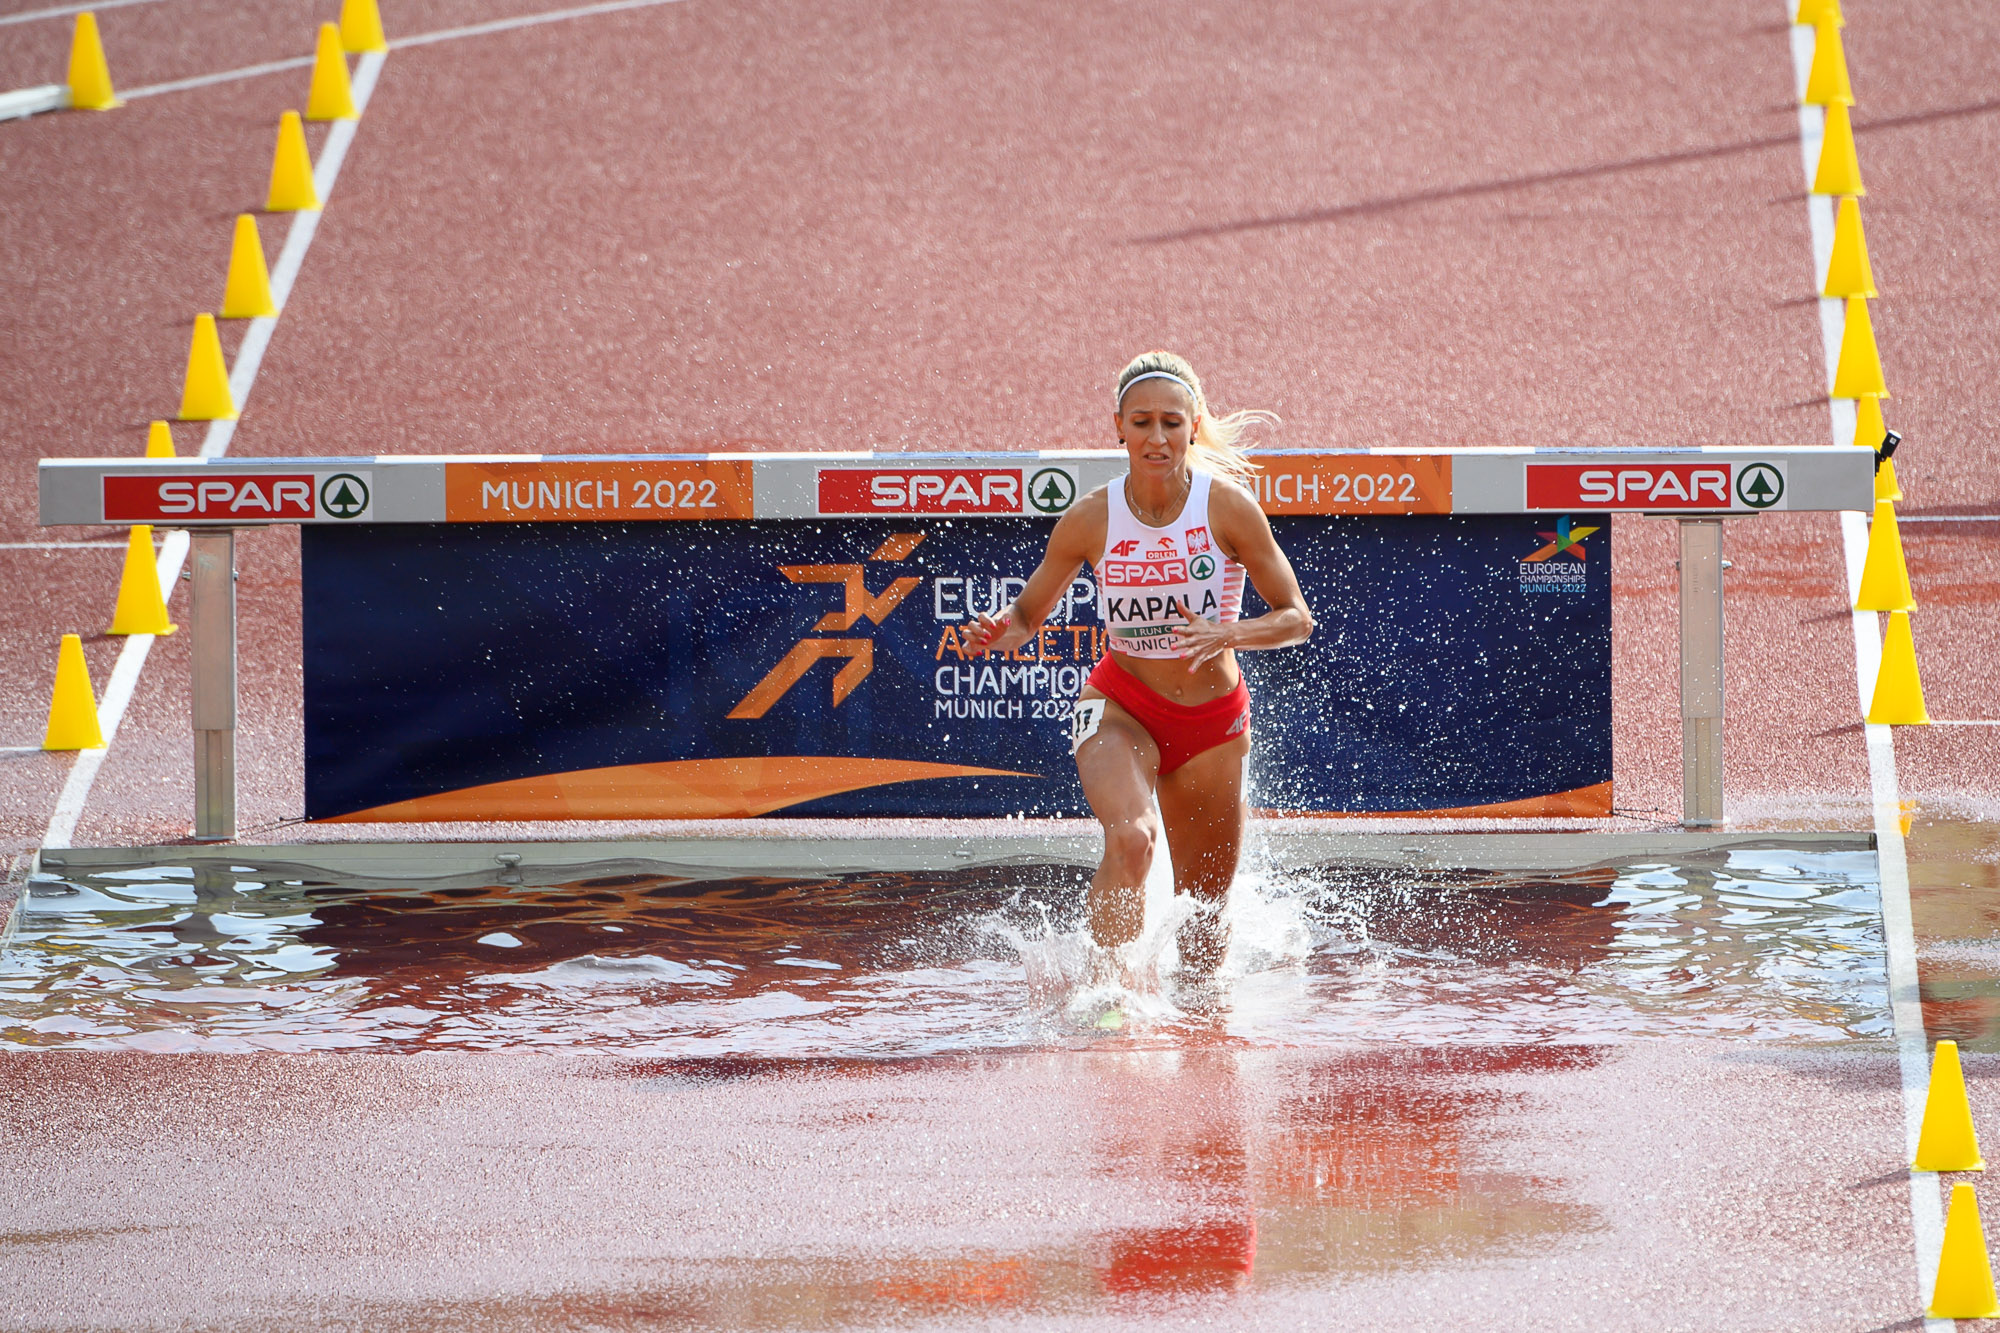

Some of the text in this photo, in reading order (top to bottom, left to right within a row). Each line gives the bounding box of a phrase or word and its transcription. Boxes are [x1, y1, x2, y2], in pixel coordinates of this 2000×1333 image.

[158, 480, 311, 513] SPAR
[481, 480, 717, 510] MUNICH 2022
[870, 474, 1019, 507] SPAR
[1333, 474, 1416, 502] 2022
[1579, 470, 1727, 503] SPAR
[1110, 540, 1140, 556] 4F
[1147, 550, 1176, 560] ORLEN
[1107, 562, 1186, 583] SPAR
[1519, 562, 1586, 574] EUROPEAN
[1519, 575, 1586, 584] CHAMPIONSHIPS
[1519, 583, 1586, 593] MUNICH 2022
[1140, 627, 1162, 636] RUN
[935, 699, 1023, 718] MUNICH
[1225, 709, 1248, 735] 4F
